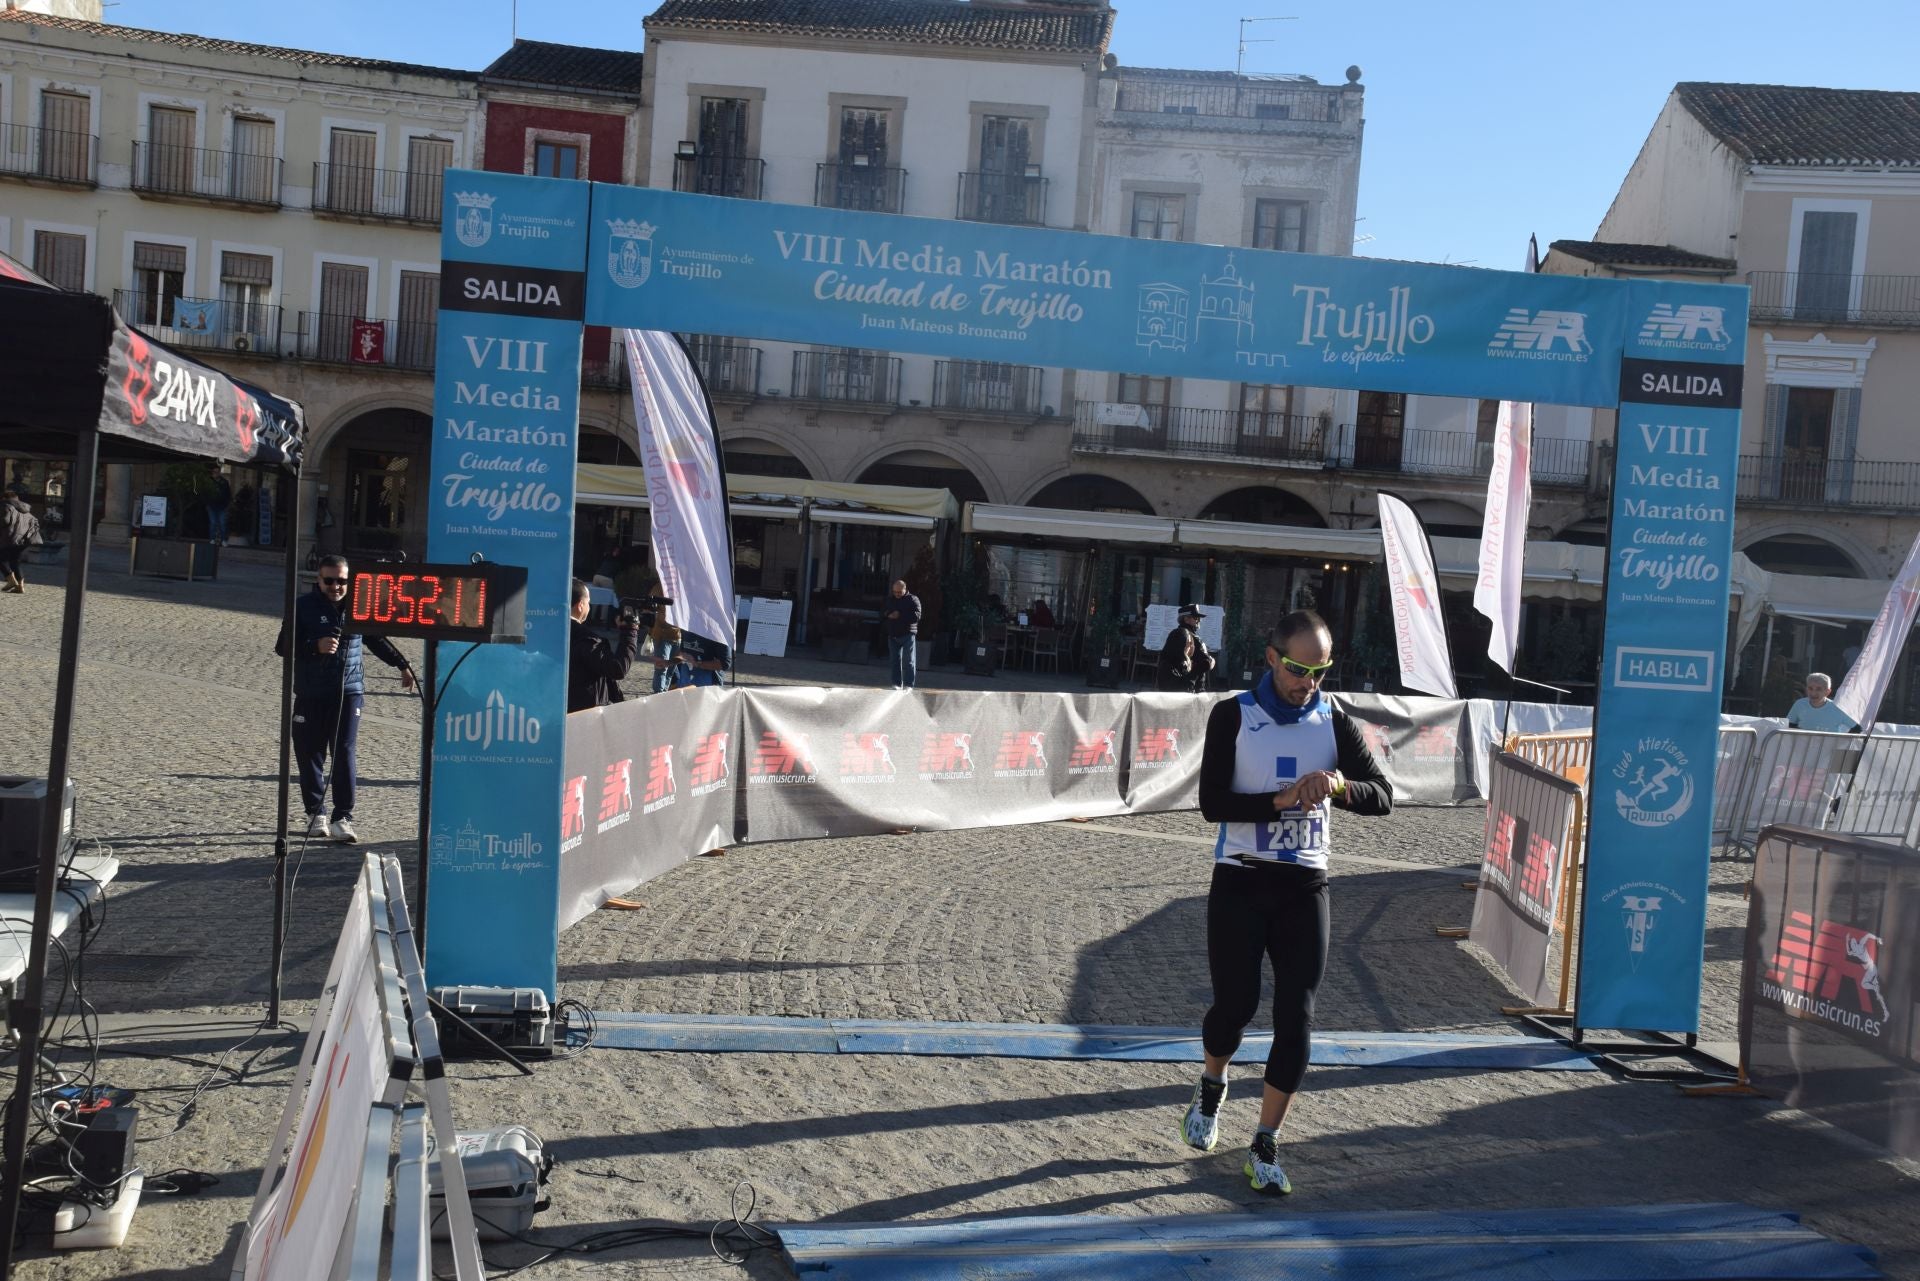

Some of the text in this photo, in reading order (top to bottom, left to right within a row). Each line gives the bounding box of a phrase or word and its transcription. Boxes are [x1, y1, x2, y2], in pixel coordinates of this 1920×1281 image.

[497, 223, 550, 240] Trujillo
[499, 211, 576, 228] Ayuntamiento de
[660, 245, 755, 265] Ayuntamiento de
[773, 230, 1113, 289] VIII Media Maratón
[660, 259, 722, 280] Trujillo
[463, 277, 562, 307] SALIDA
[814, 270, 1084, 330] Ciudad de Trujillo
[860, 313, 1028, 342] Juan Mateos Broncano
[1292, 283, 1435, 355] Trujillo
[462, 335, 549, 373] VIII
[1322, 341, 1338, 363] te
[1486, 348, 1589, 363] www.musicrun.es
[1638, 338, 1727, 352] www.musicrun.es
[453, 380, 561, 411] Media
[1640, 372, 1724, 397] SALIDA
[444, 418, 568, 447] Maratón
[1637, 423, 1710, 456] VIII
[459, 452, 549, 474] Ciudad de
[1629, 464, 1721, 490] Media
[442, 473, 561, 521] Trujillo
[1623, 497, 1727, 522] Maratón
[445, 523, 558, 539] Juan Mateos Broncano
[1632, 527, 1709, 547] Ciudad de
[1619, 547, 1720, 590] Trujillo
[1621, 592, 1642, 602] Juan
[1676, 595, 1716, 606] Broncano
[1628, 658, 1699, 680] HABLA
[445, 688, 541, 751] trujillo
[1612, 736, 1689, 778] Club Atletismo
[749, 773, 817, 785] www.musicrun.es
[993, 768, 1045, 778] www.musicrun.es
[483, 832, 543, 859] Trujillo
[1267, 819, 1311, 850] 238
[1602, 888, 1618, 903] Club
[1762, 981, 1881, 1038] www.musicrun.es
